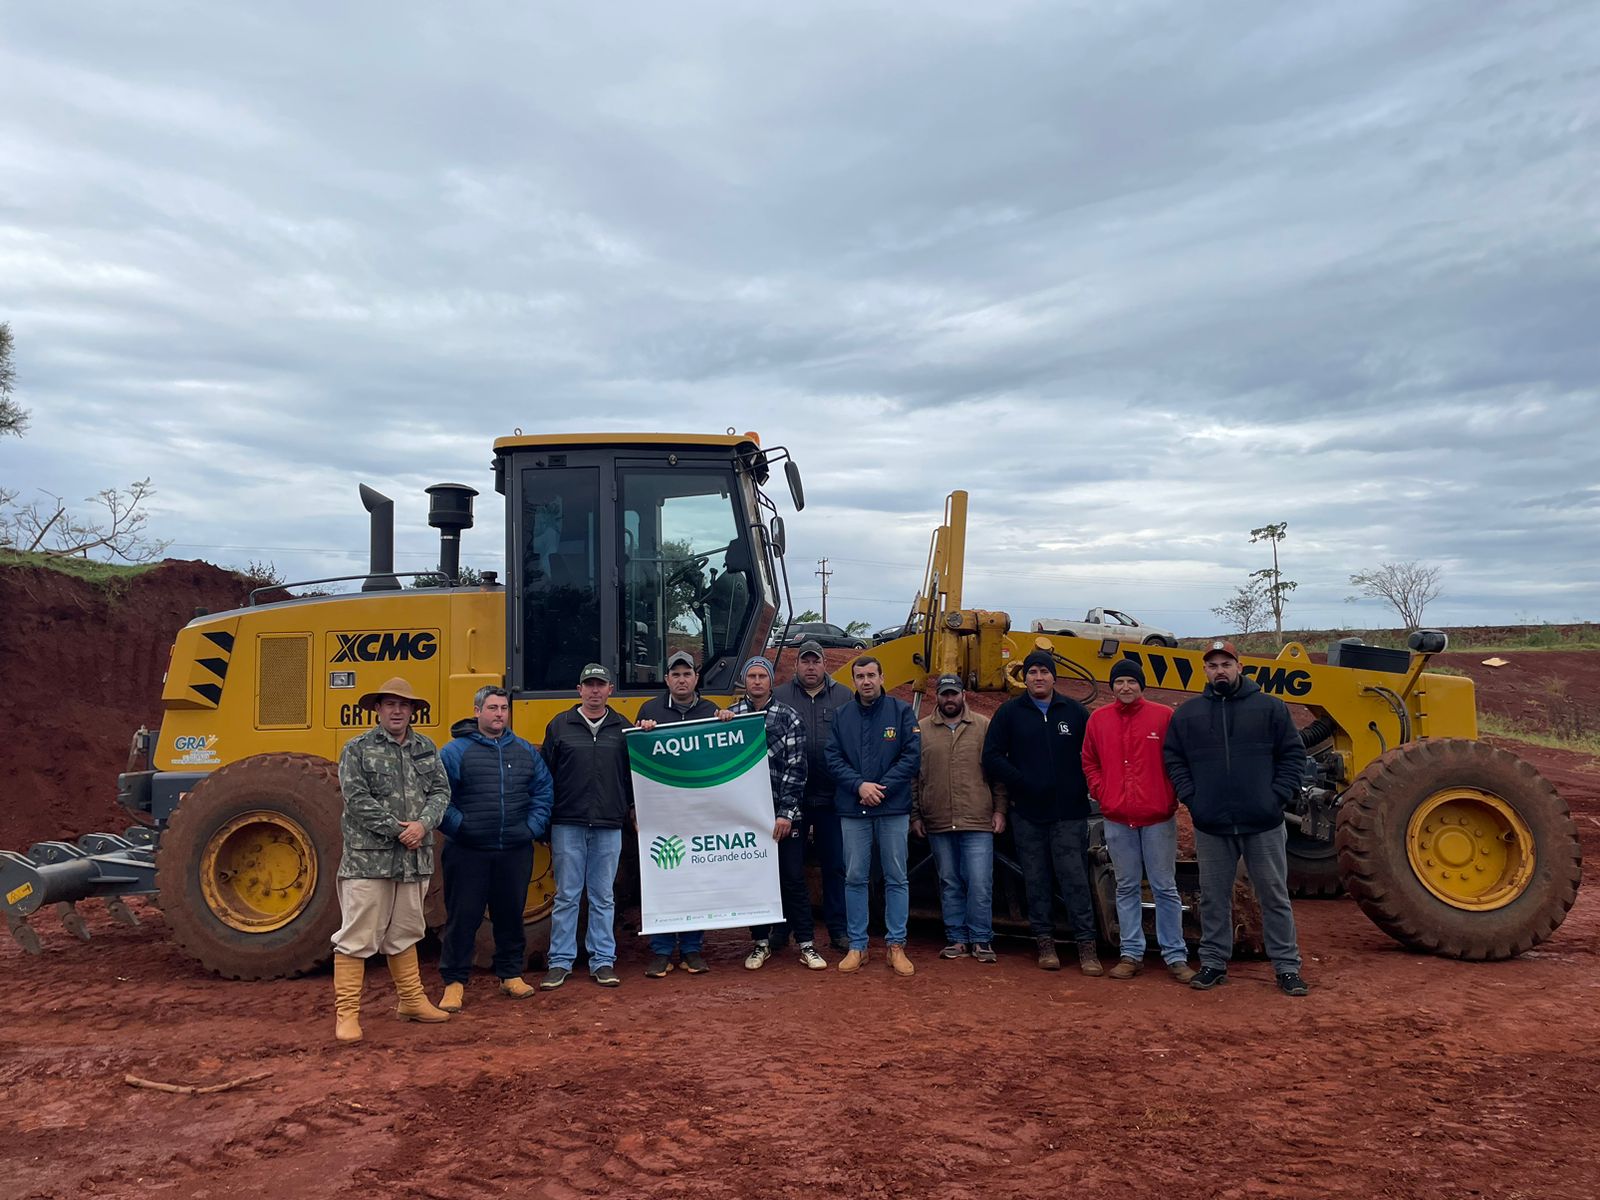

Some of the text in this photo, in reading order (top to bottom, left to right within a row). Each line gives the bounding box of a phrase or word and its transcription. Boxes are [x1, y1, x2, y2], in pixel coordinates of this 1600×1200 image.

[330, 632, 437, 663] XCMG
[652, 729, 745, 756] AQUI TEM
[691, 831, 757, 852] SENAR
[691, 848, 768, 864] Rio Grande do Sul
